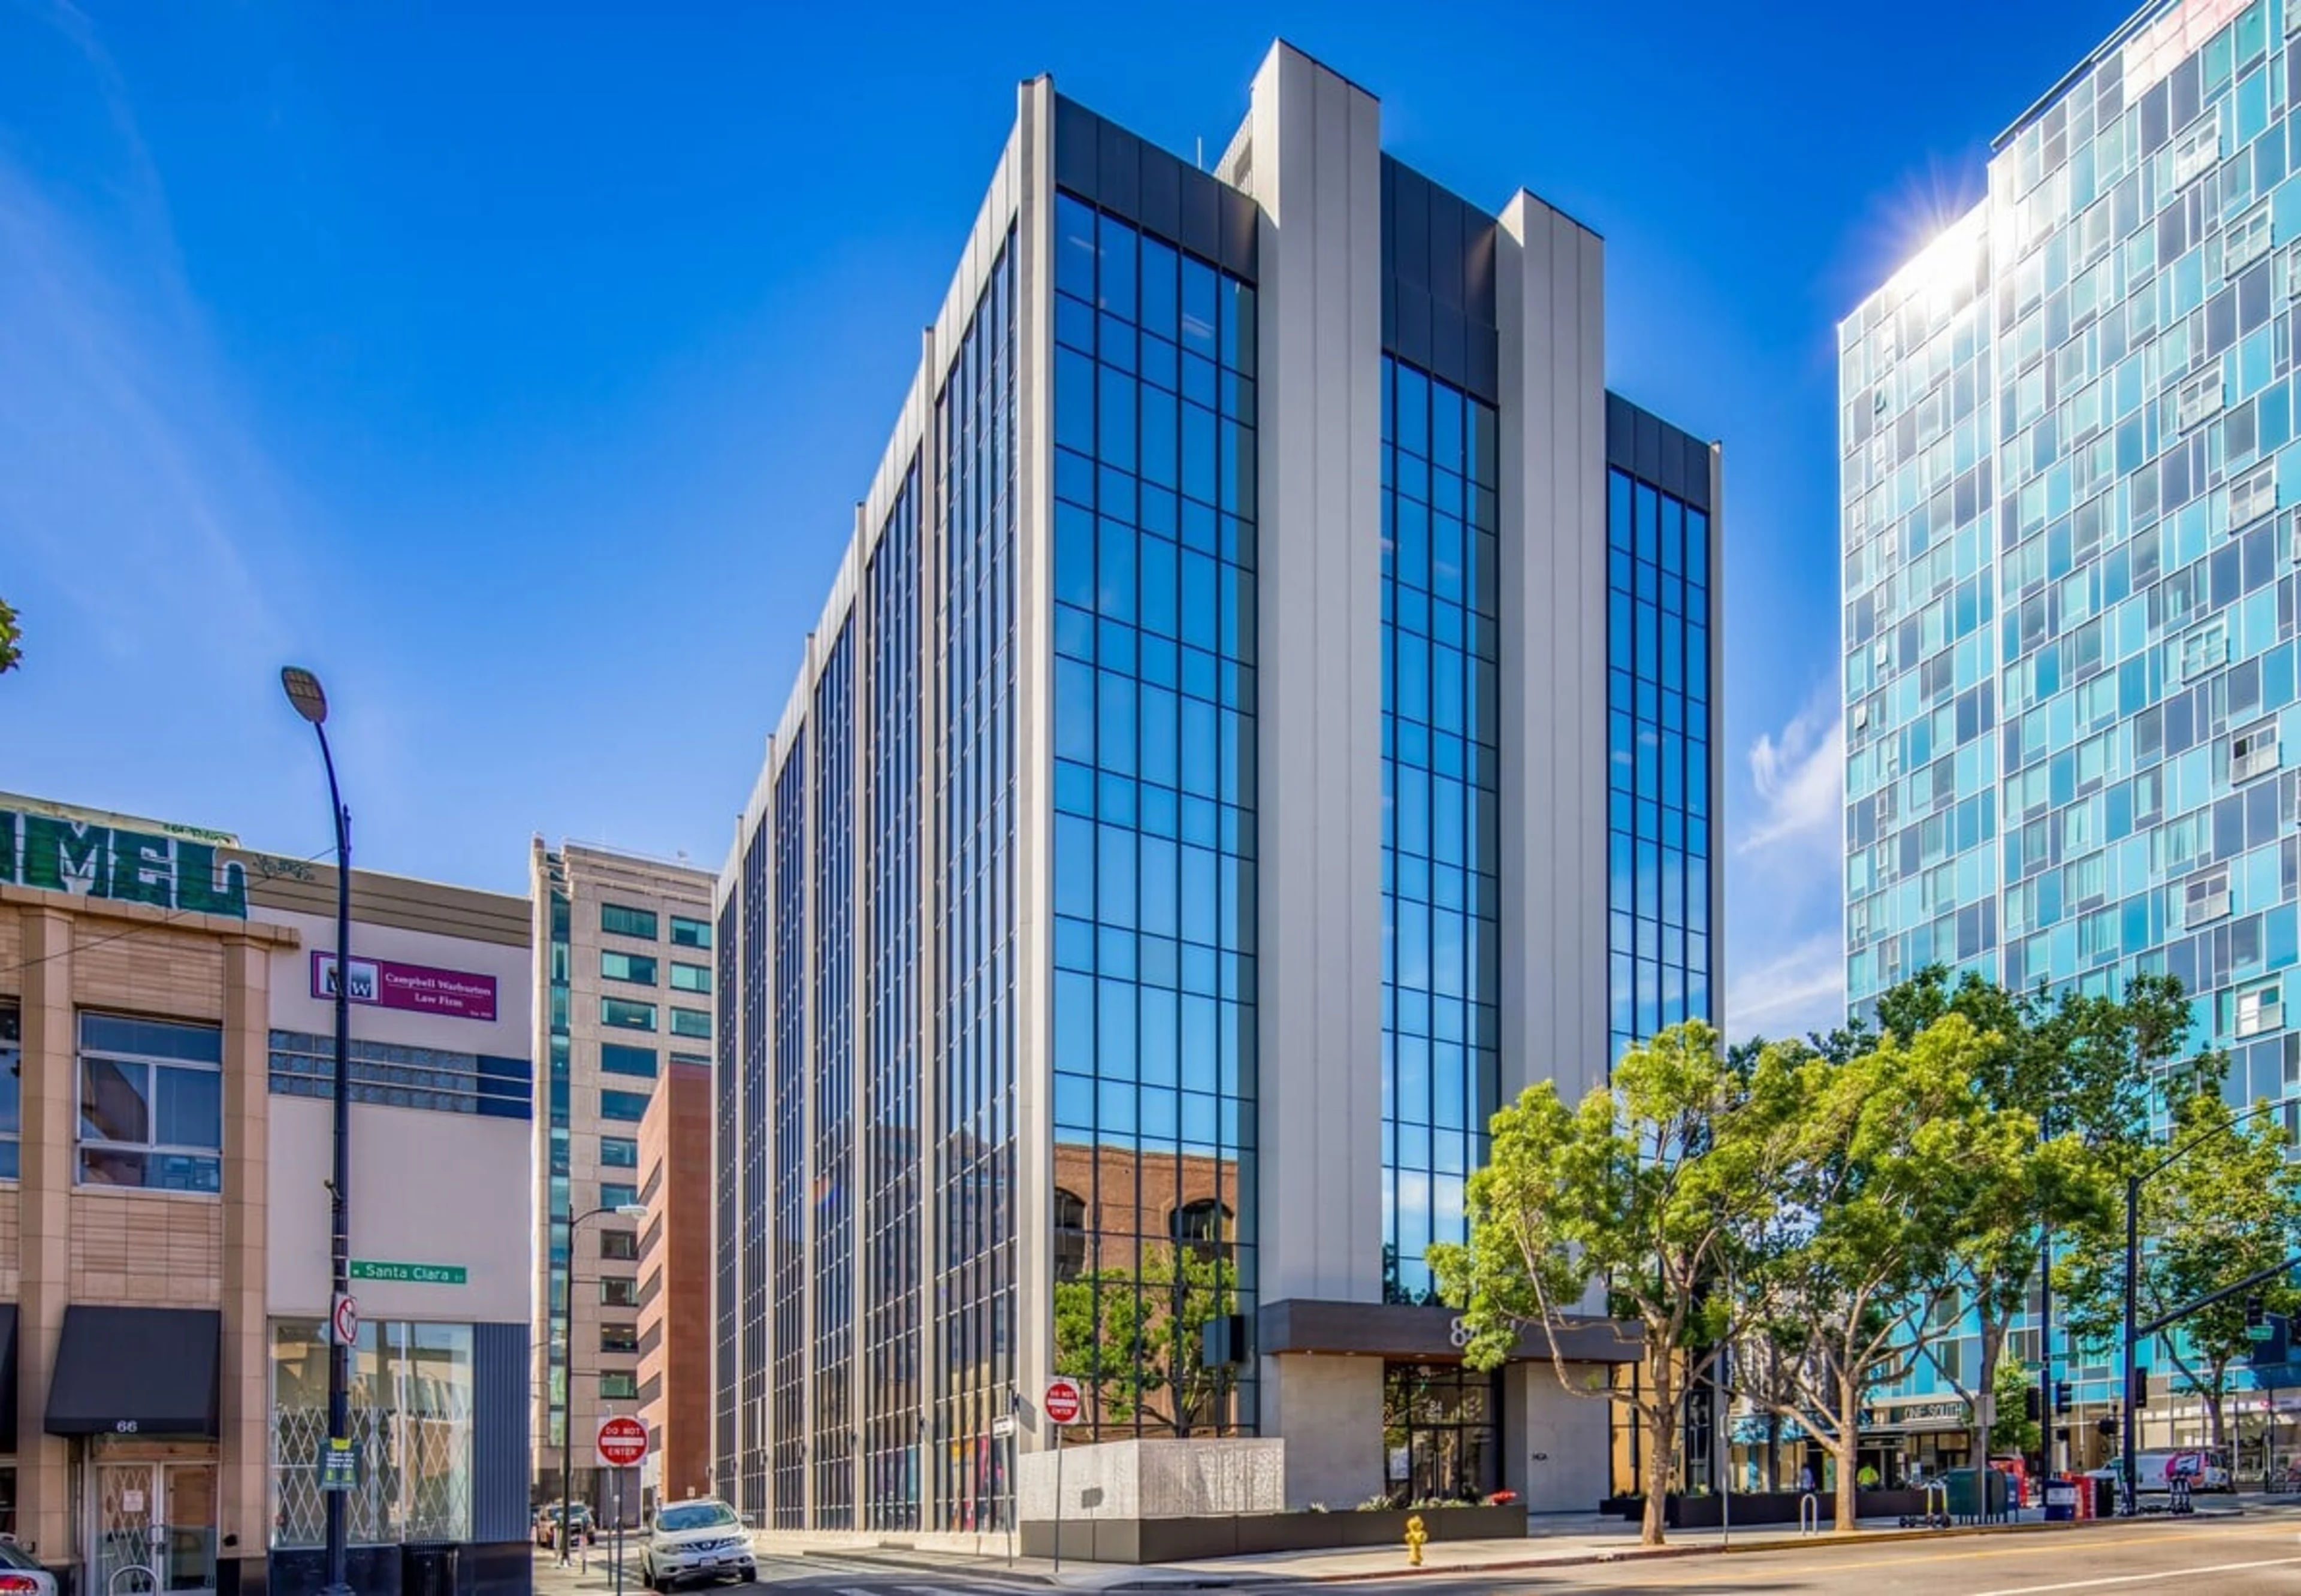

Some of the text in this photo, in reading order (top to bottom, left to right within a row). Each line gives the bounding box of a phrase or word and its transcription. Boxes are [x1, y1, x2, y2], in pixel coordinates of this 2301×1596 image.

[385, 972, 491, 996] Campbell Warburton
[414, 992, 463, 1008] Law Firm
[366, 1264, 408, 1278] Santa
[412, 1267, 449, 1281] Clara
[1061, 1390, 1074, 1398] NOT
[1928, 1402, 1962, 1418] SOUTH
[116, 1419, 138, 1433] 66
[605, 1426, 641, 1436] DO NOT
[607, 1446, 638, 1456] ENTER
